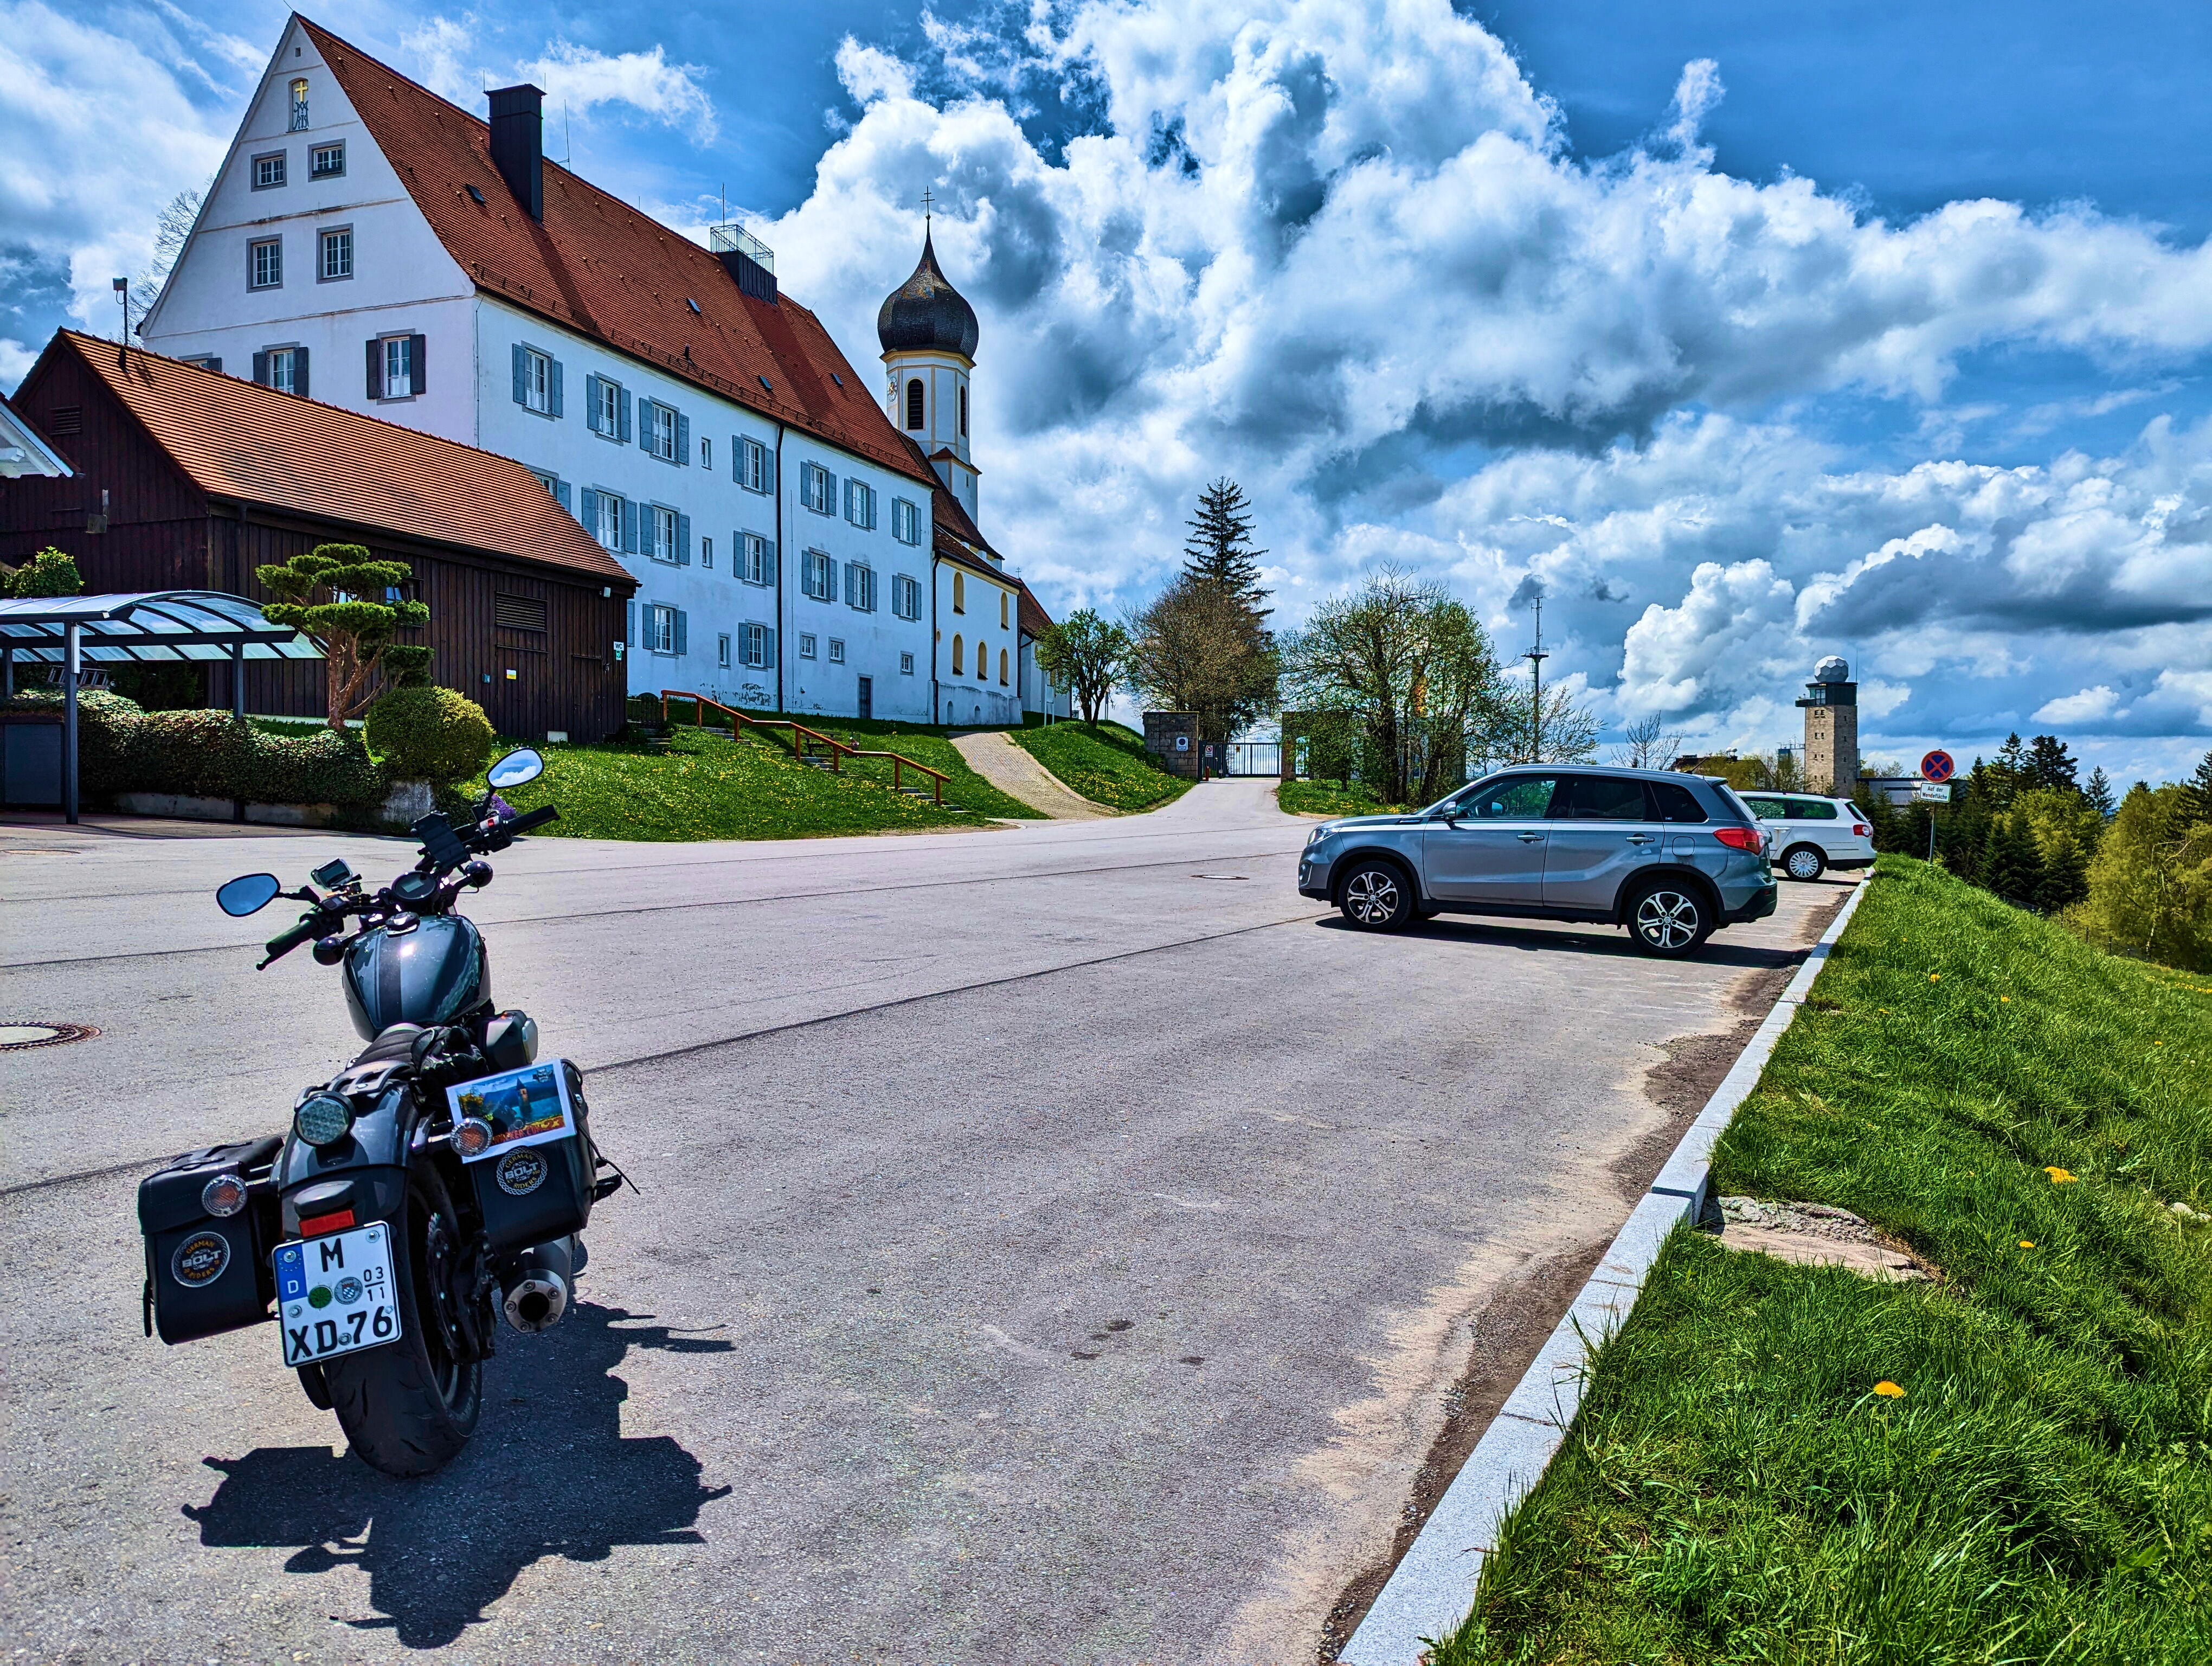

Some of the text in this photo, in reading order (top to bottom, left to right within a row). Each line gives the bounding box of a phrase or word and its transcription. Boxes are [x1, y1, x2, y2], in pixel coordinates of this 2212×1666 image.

[505, 1154, 534, 1168] GERMAN
[504, 1162, 538, 1180] BOLT
[513, 1176, 537, 1189] RIDERS
[182, 1250, 222, 1268] BOLT
[320, 1238, 344, 1272] M
[363, 1266, 384, 1282] 03
[287, 1280, 299, 1294] D
[367, 1286, 385, 1302] 11
